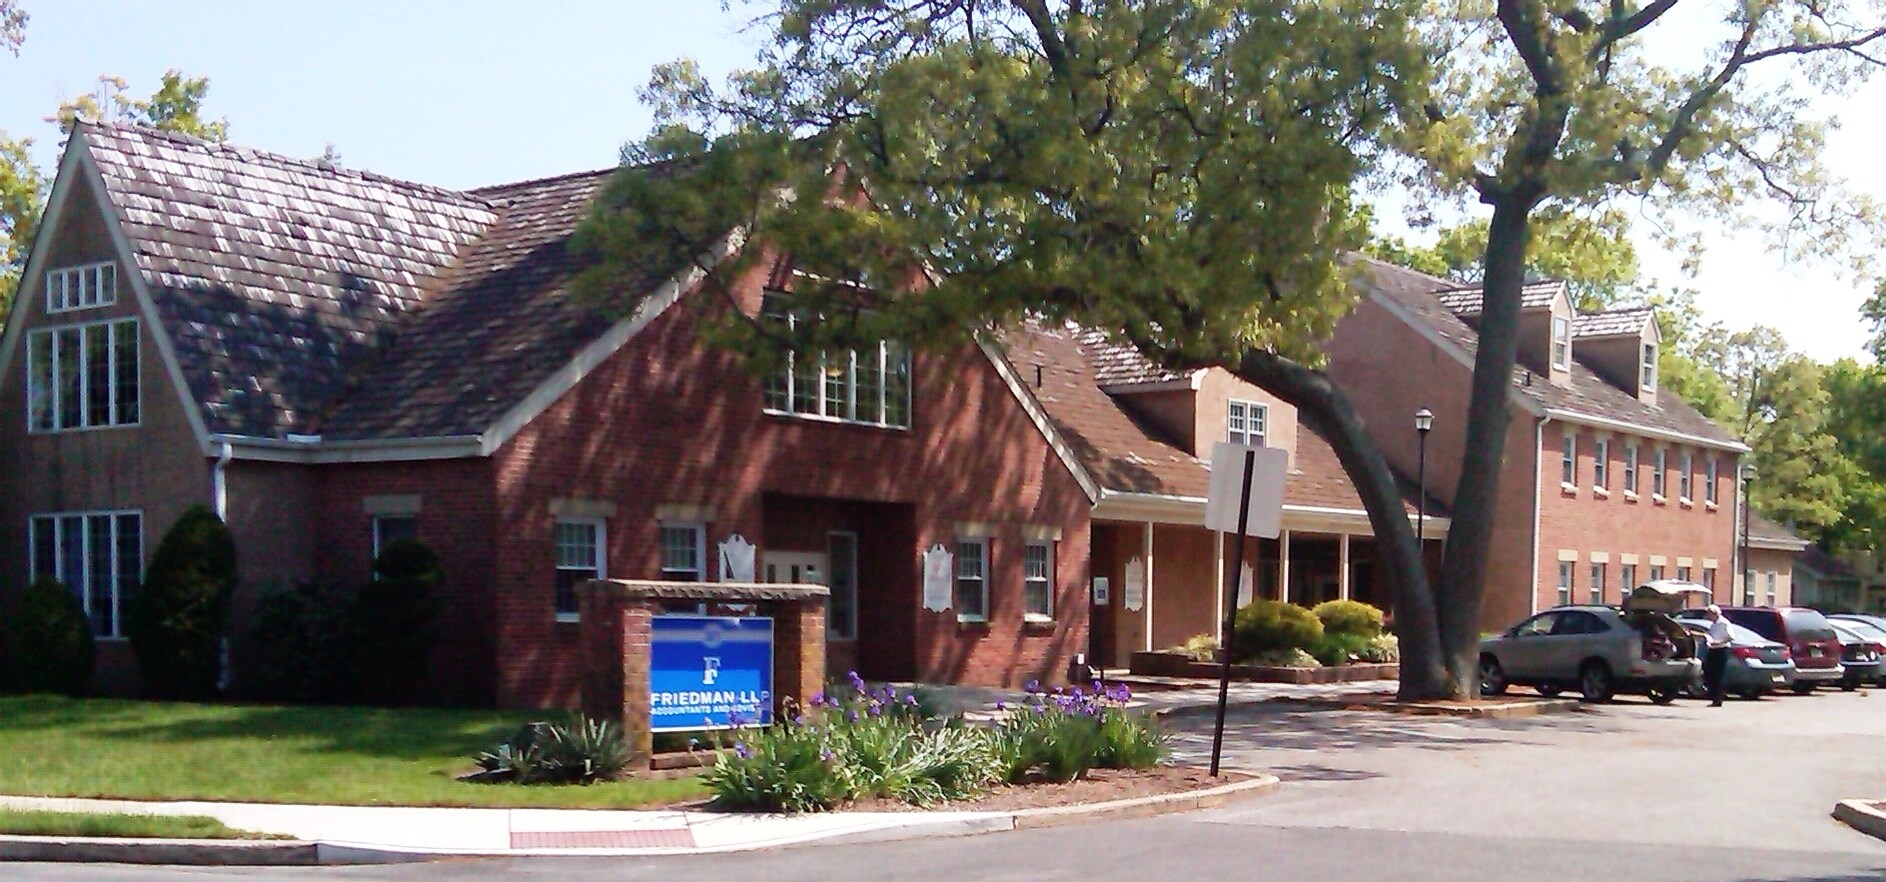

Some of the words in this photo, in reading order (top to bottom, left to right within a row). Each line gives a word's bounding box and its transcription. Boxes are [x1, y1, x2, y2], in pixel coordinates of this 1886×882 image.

[703, 656, 721, 685] F
[651, 691, 735, 705] FRIEDMAN
[740, 690, 770, 704] LLP
[651, 704, 711, 715] ACCOUNTANTS
[713, 704, 730, 713] AND
